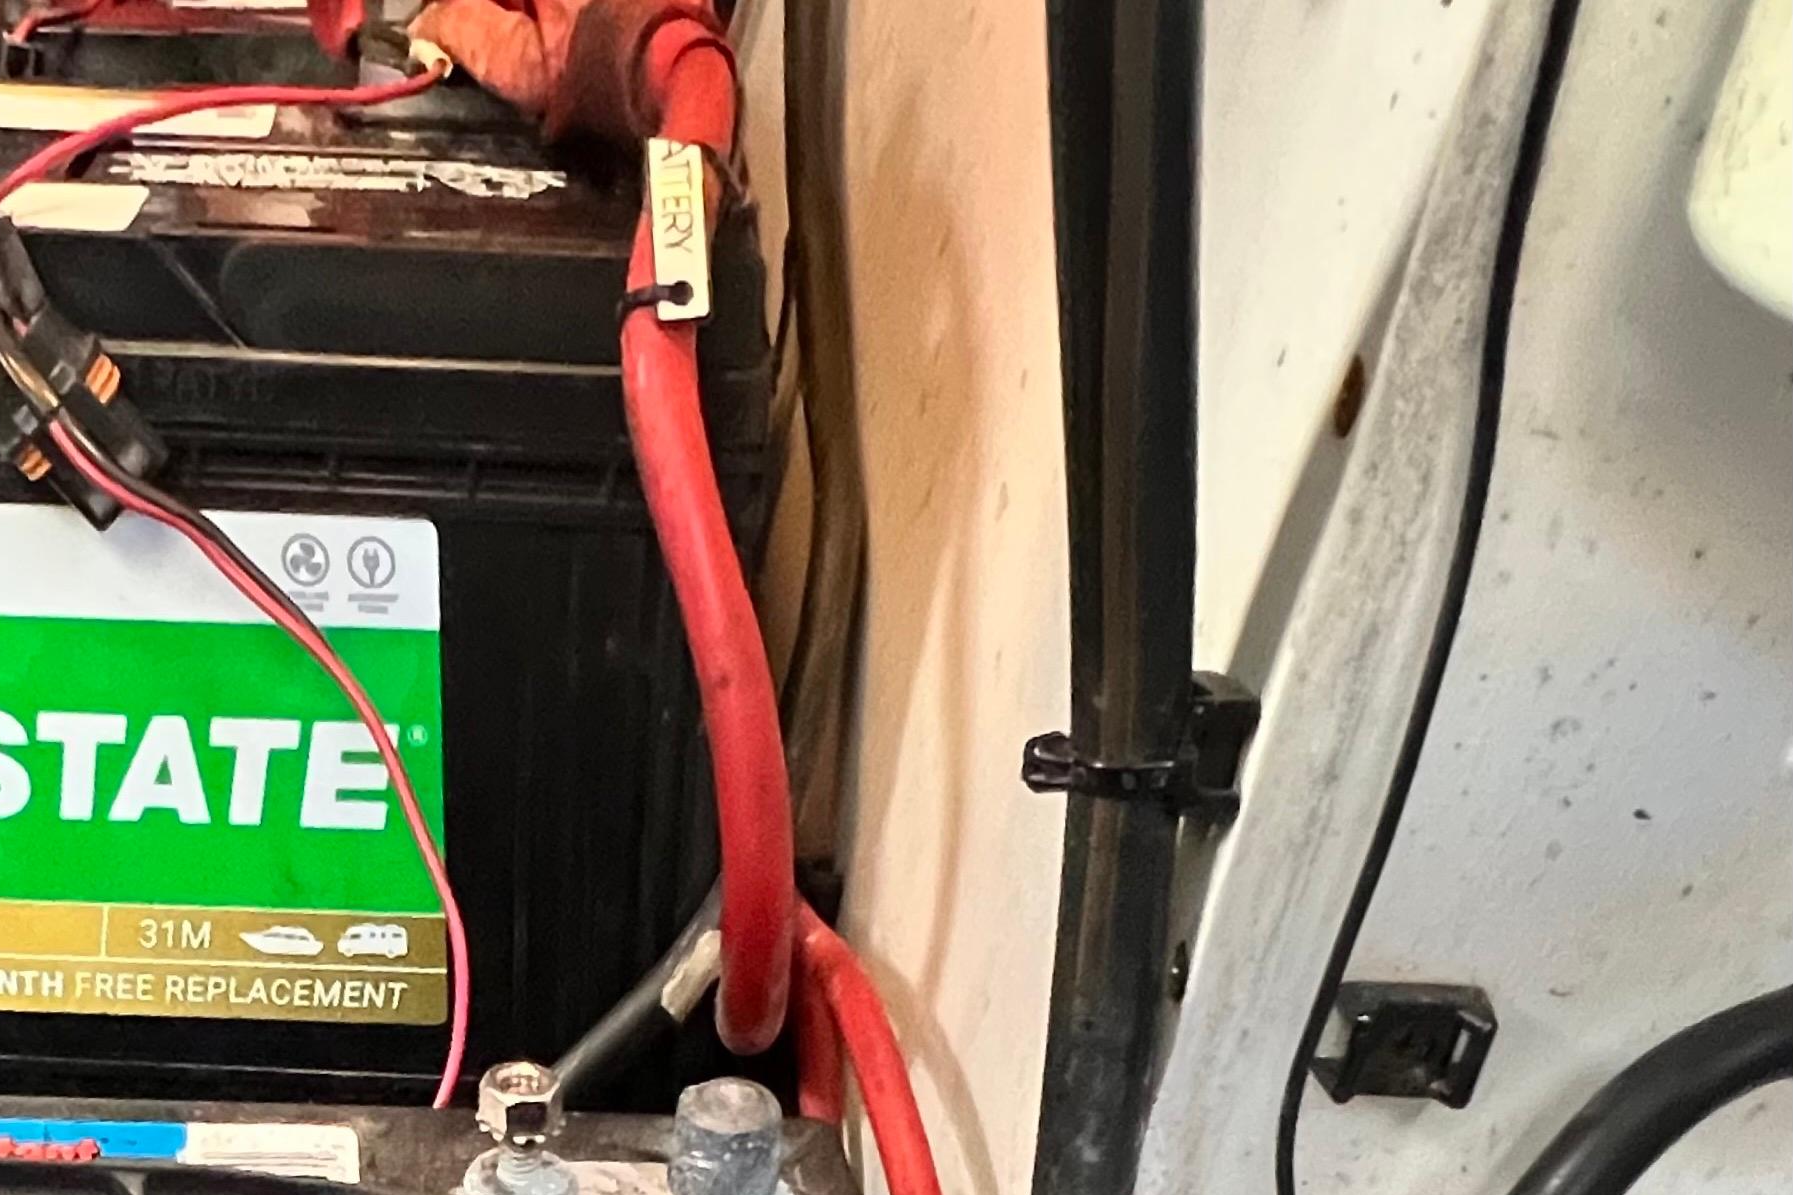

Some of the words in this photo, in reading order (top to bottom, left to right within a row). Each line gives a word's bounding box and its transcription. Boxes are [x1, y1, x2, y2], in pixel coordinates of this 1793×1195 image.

[661, 141, 693, 253] ATTERY
[139, 918, 212, 950] 31M
[74, 972, 153, 1001] FREE
[164, 974, 408, 1010] REPLACEMENT
